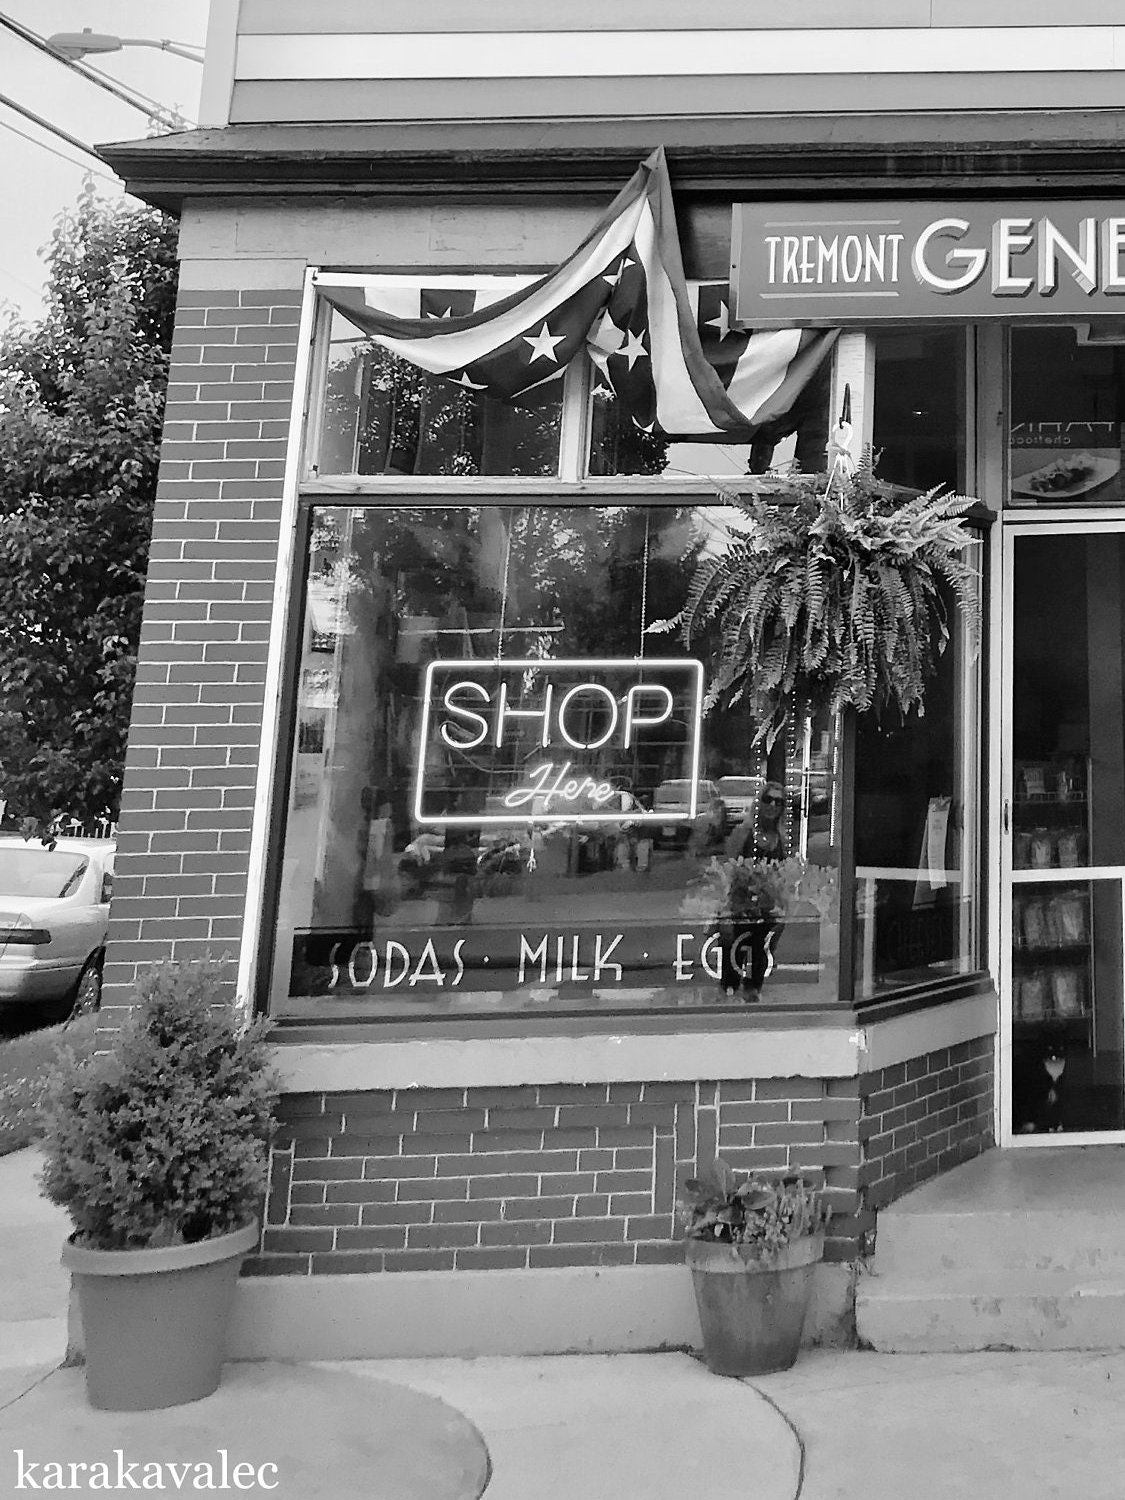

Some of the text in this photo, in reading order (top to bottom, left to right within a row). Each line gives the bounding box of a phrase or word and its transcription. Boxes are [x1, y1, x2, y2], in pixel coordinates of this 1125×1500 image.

[764, 233, 905, 285] TREMONT
[440, 682, 674, 749] SHOP
[504, 761, 616, 807] Here
[327, 931, 777, 989] SODAS MILK EGGS
